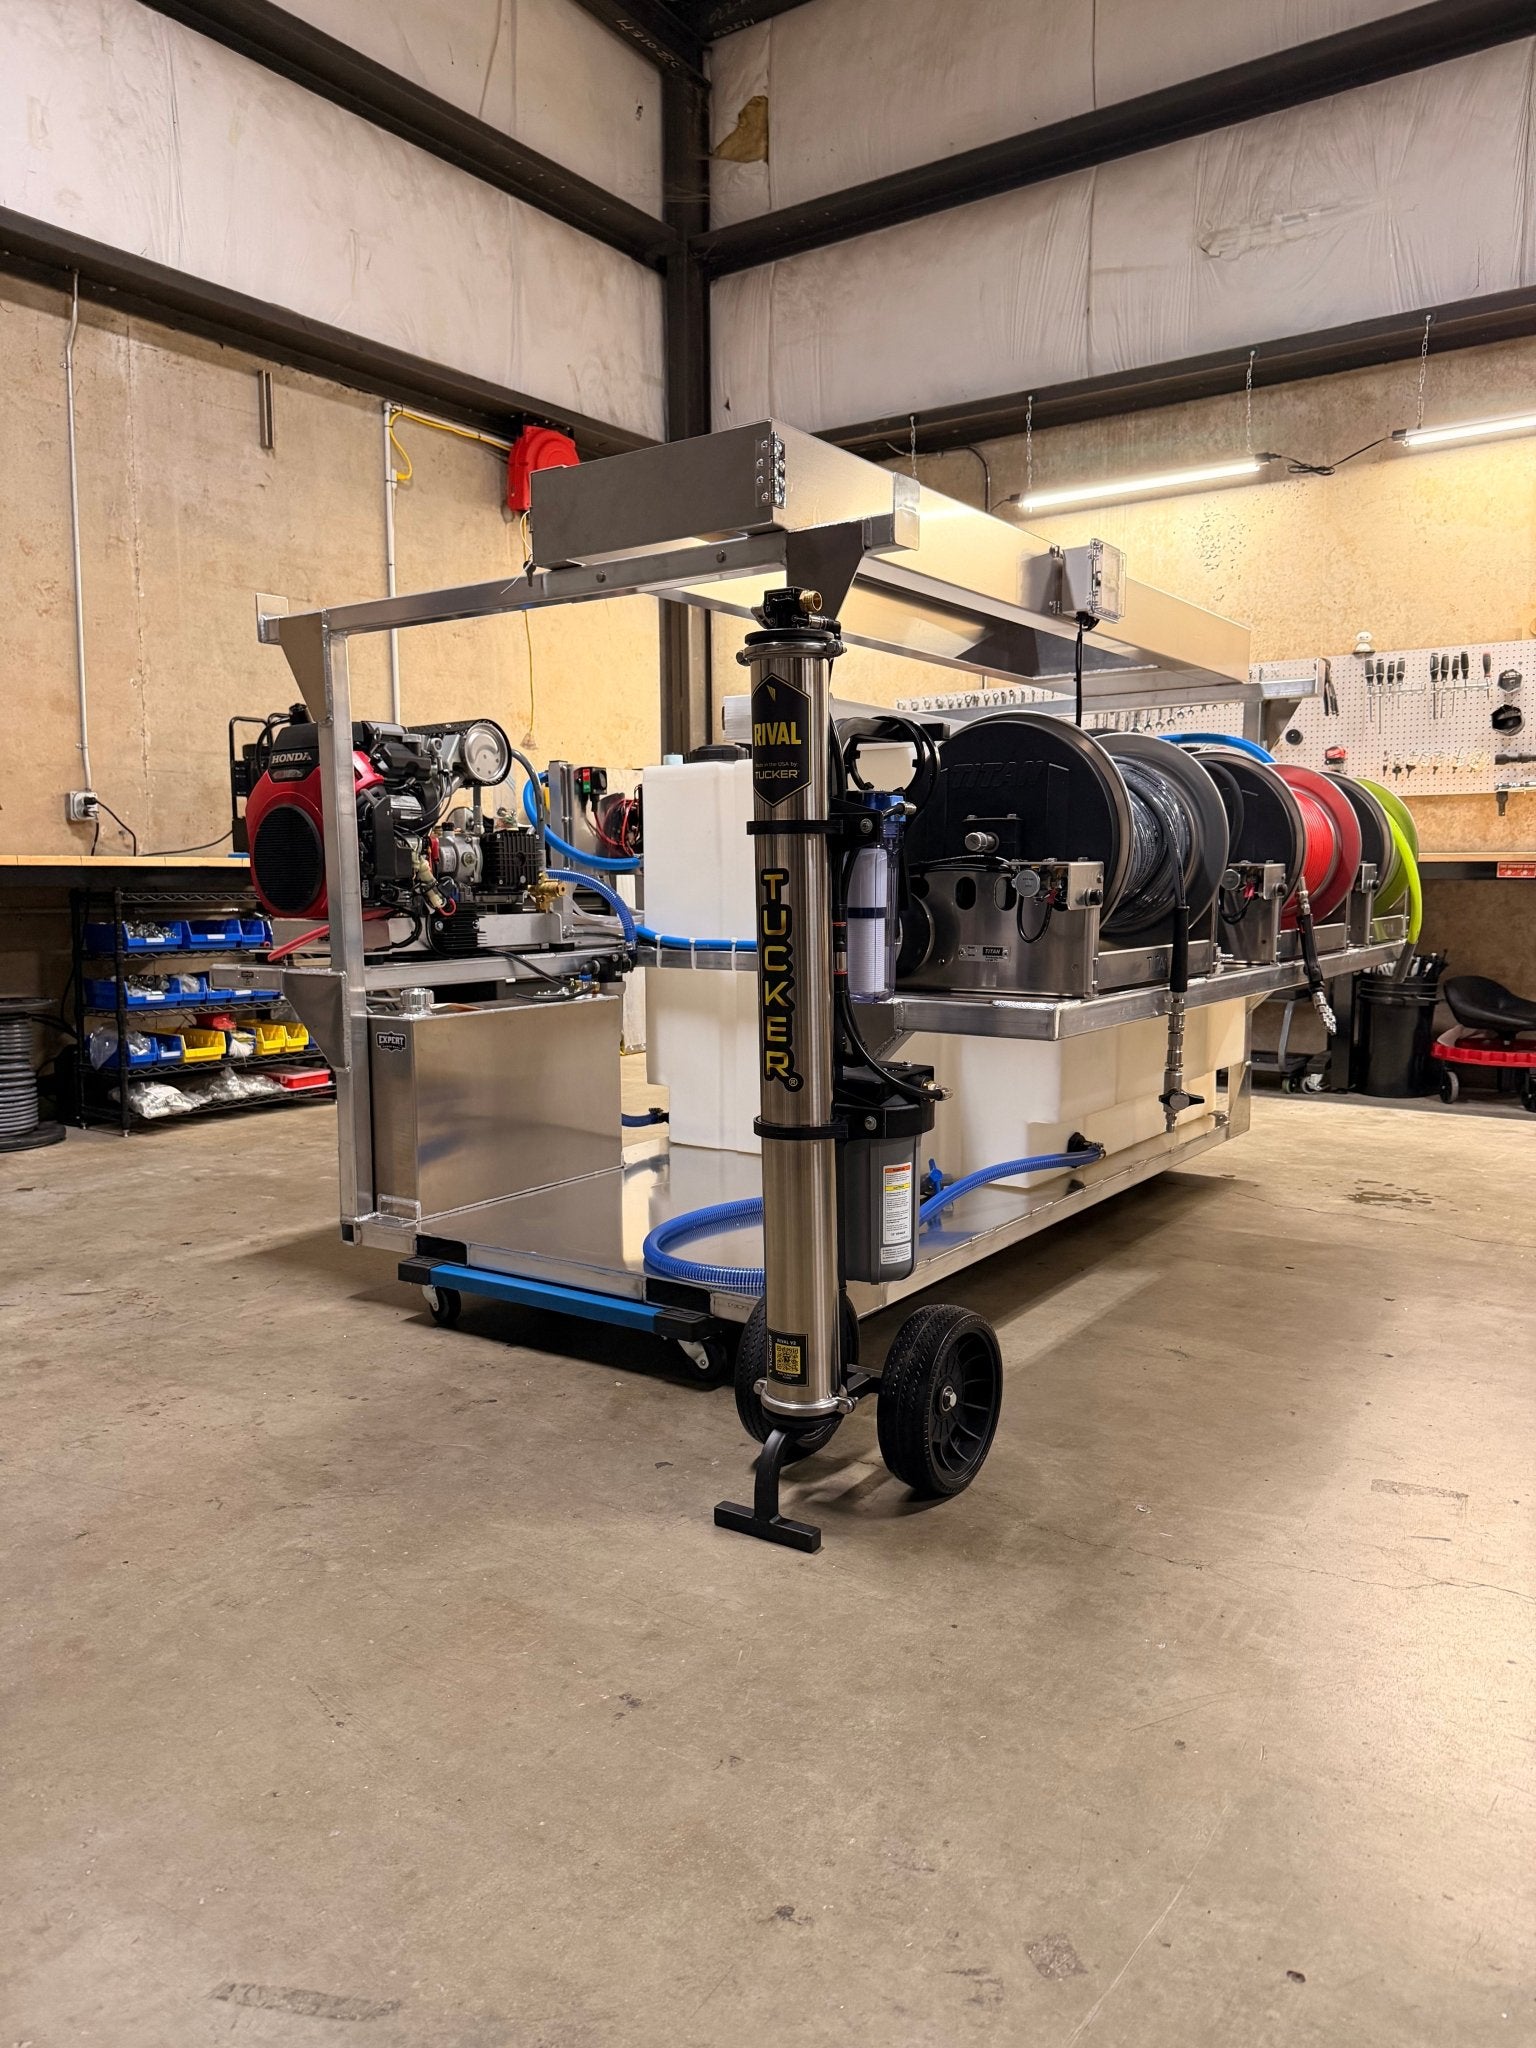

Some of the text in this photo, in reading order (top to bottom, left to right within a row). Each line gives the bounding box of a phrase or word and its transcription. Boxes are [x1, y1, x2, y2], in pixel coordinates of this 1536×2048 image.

[754, 721, 802, 747] RIVAL
[271, 752, 312, 764] HONDA
[754, 769, 799, 780] TUCKER
[378, 1035, 404, 1045] EXPERT
